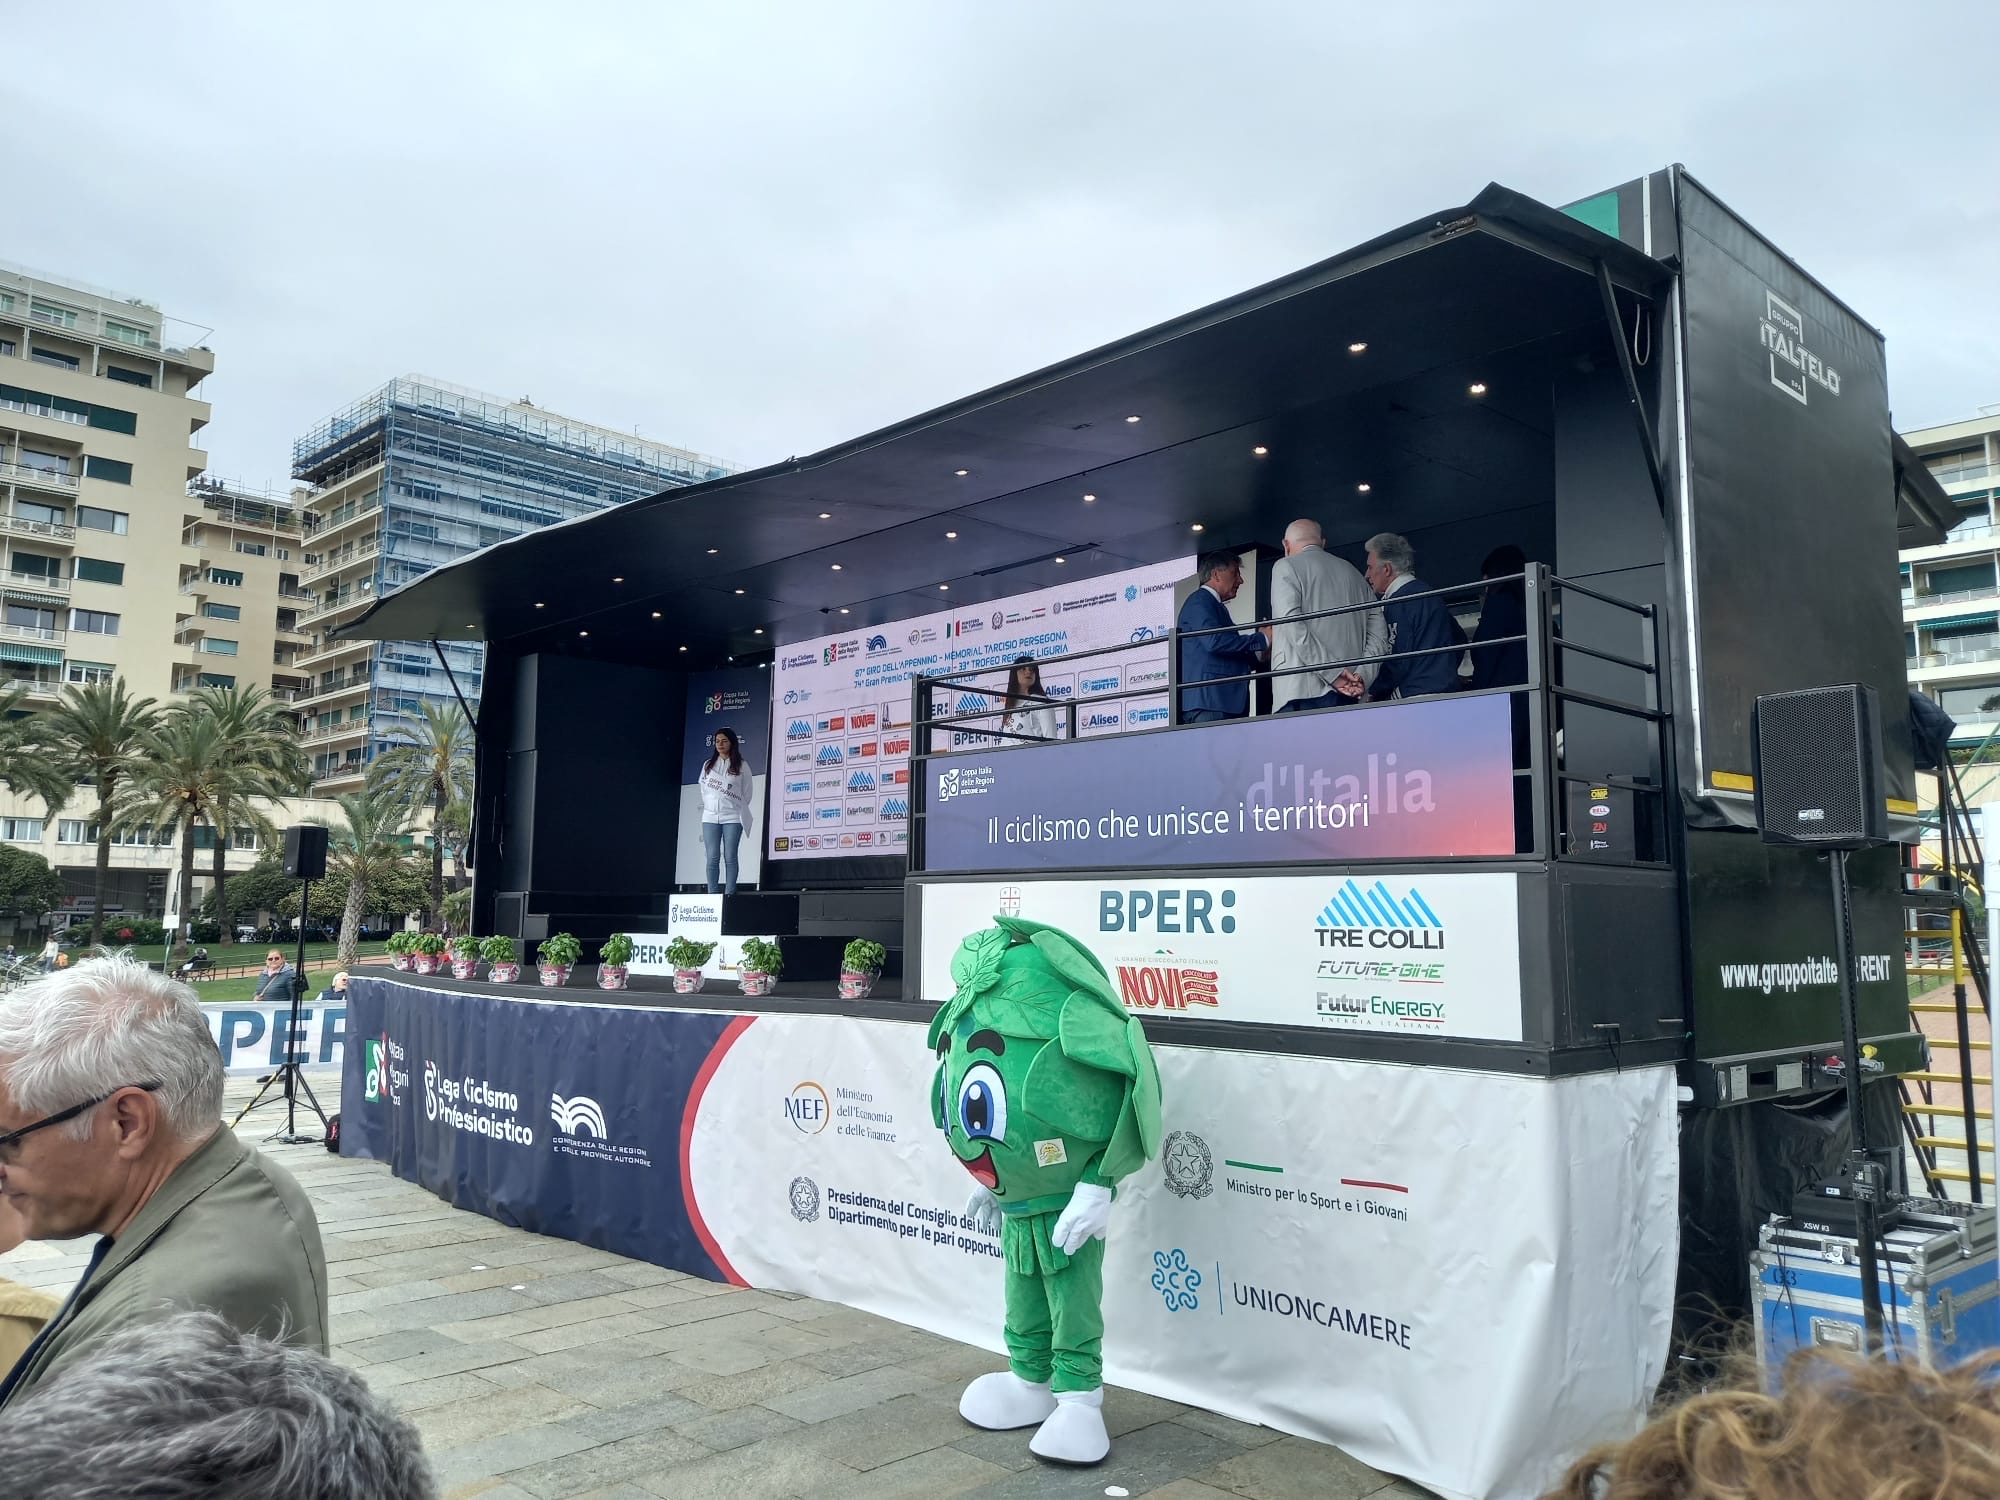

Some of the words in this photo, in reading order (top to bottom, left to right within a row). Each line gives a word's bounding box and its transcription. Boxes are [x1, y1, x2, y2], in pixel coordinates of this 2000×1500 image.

[1772, 309, 1799, 336] GRUPPO
[1760, 319, 1841, 396] ITALTELO
[1791, 379, 1802, 391] SPA
[1144, 582, 1175, 594] UNIONCAM
[866, 665, 881, 676] GIRO
[882, 654, 938, 673] DELL'APPENNINO
[945, 646, 982, 662] MEMORIAL
[984, 638, 1018, 653] TARCISIO
[1019, 630, 1067, 646] PERSEGONA
[866, 677, 879, 687] Gran
[881, 673, 902, 685] Premio
[926, 665, 951, 676] Genova
[972, 655, 1000, 668] TROFEO
[1037, 643, 1068, 657] LIGURIA
[1046, 686, 1072, 696] Aliseo
[1091, 682, 1119, 691] REPETTO
[1089, 714, 1119, 726] Aliseo
[1139, 712, 1168, 721] REPETTO
[884, 741, 901, 755] NOVI
[848, 785, 858, 793] TRE
[859, 784, 875, 792] COLLI
[976, 775, 995, 786] Regioni
[1246, 752, 1436, 819] d'Italia
[790, 810, 809, 820] Aliseo
[988, 816, 999, 844] Il
[1005, 814, 1090, 844] ciclismo
[1098, 809, 1139, 839] che
[1147, 805, 1229, 837] unisce
[1238, 801, 1244, 833] i
[1253, 794, 1370, 832] territori
[680, 905, 692, 914] Lega
[693, 905, 715, 914] Ciclismo
[1314, 928, 1363, 948] TRE
[1369, 928, 1444, 950] COLLI
[632, 945, 663, 964] PER:
[1720, 955, 1859, 994] www.gruppoitalte
[1860, 955, 1890, 982] RENT
[1116, 966, 1187, 1009] NOVI
[1321, 1016, 1371, 1025] ENERGIA
[1381, 1020, 1440, 1030] ITALIANA
[201, 1008, 348, 1067] PER
[437, 1068, 460, 1102] Lega
[836, 1087, 873, 1103] Ministero
[784, 1096, 825, 1120] MEF
[837, 1125, 843, 1135] e
[845, 1123, 866, 1137] delle
[581, 1150, 613, 1161] PROVINCE
[615, 1156, 652, 1167] AUTONOME
[619, 1146, 647, 1157] REGIONI
[1226, 1178, 1272, 1198] Ministro
[1275, 1187, 1295, 1202] per
[1298, 1189, 1307, 1203] lo
[1310, 1192, 1341, 1210] Sport
[1344, 1201, 1352, 1212] e
[1364, 1200, 1408, 1222] Giovani
[828, 1187, 887, 1212] Presidenza
[888, 1195, 904, 1217] del
[907, 1203, 958, 1228] Consiglio
[960, 1214, 975, 1232] dei
[828, 1206, 898, 1233] Dipartimento
[900, 1221, 919, 1241] per
[921, 1222, 932, 1242] le
[934, 1230, 955, 1247] pari
[958, 1236, 1003, 1259] opportu
[1803, 1221, 1820, 1231] XSW
[1233, 1282, 1411, 1350] UNIONCAMERE
